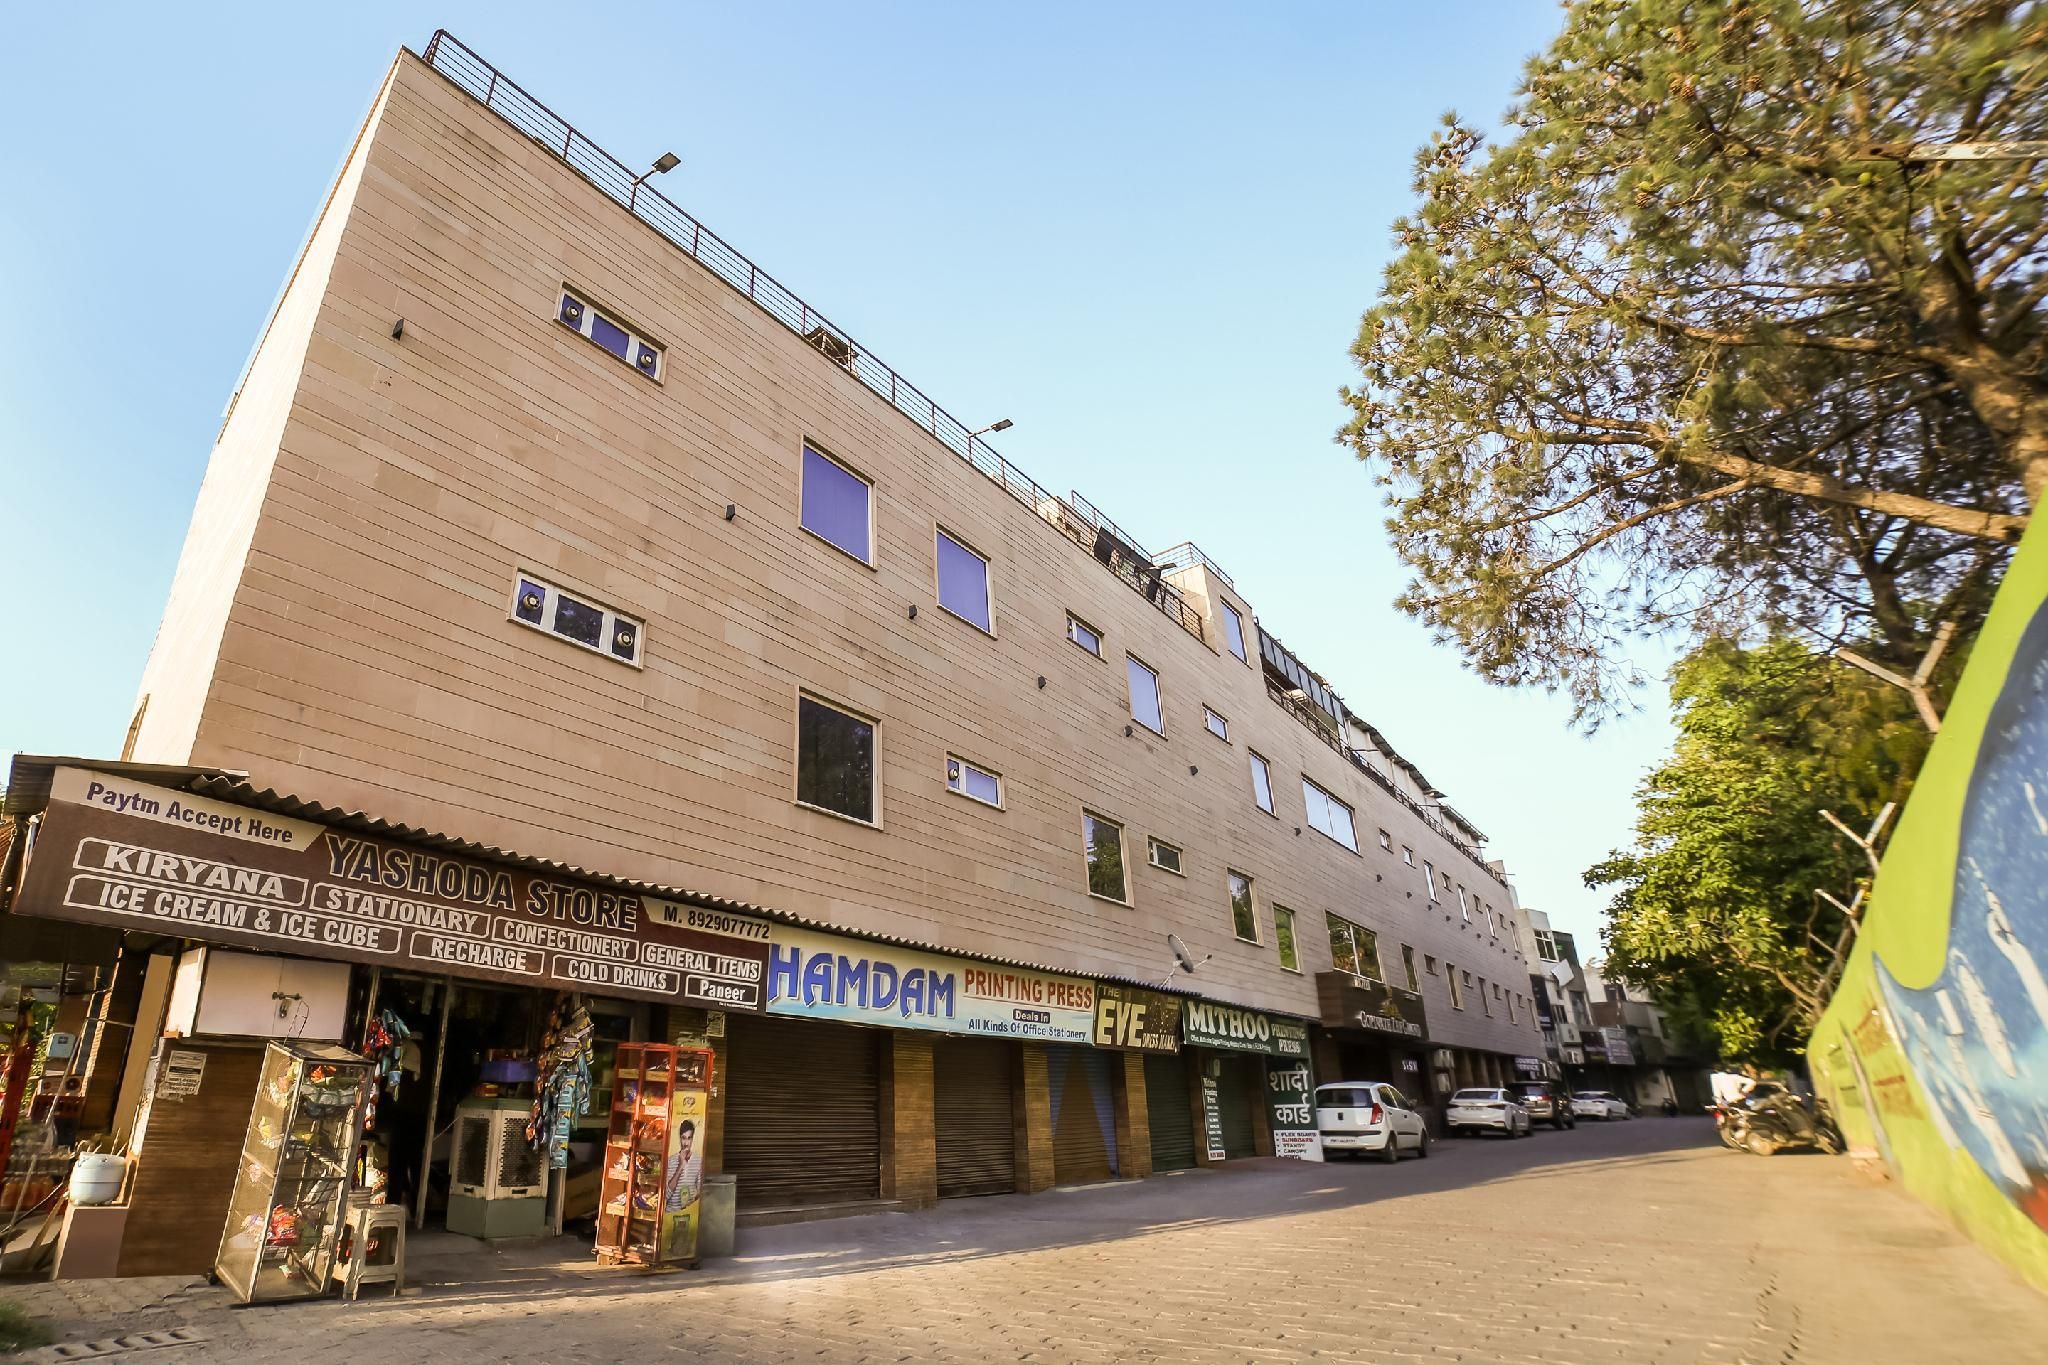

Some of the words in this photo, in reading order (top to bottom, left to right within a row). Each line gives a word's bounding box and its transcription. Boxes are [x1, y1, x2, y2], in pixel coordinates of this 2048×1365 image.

[86, 781, 160, 815] Paytm
[165, 801, 241, 834] Accept
[247, 818, 293, 843] Here
[102, 846, 284, 899] KIRYANA
[323, 833, 516, 911] YASHODA
[526, 879, 638, 933] STORE
[99, 882, 145, 912] ICE
[154, 889, 247, 928] CREAM
[254, 908, 271, 931] &
[278, 911, 319, 939] ICE
[323, 920, 381, 948] CUBE
[326, 888, 478, 933] STATIONARY
[663, 905, 682, 925] M.
[687, 910, 770, 939] 8929077772
[431, 937, 527, 971] RECHARGE
[503, 921, 631, 960] CONFECTIONERY
[567, 959, 609, 983] COLD
[612, 966, 667, 991] DRINKS
[646, 945, 713, 972] GENERAL
[715, 957, 759, 979] ITEMS
[700, 979, 746, 1001] Paneer
[767, 943, 956, 1020] HAMDAM
[964, 968, 1042, 1003] PRINTING
[1047, 982, 1092, 1009] PRESS
[1103, 986, 1120, 998] THE
[968, 1019, 980, 1030] All
[983, 1020, 1008, 1033] Kinds
[1010, 1022, 1021, 1033] Of
[1023, 1023, 1046, 1036] Office
[1049, 1025, 1086, 1041] Statonery
[1015, 1010, 1038, 1021] Deals
[1040, 1012, 1049, 1023] In
[1096, 999, 1146, 1047] EVE
[1187, 1001, 1270, 1042] MITHOO
[1279, 1039, 1301, 1053] PRESS
[1269, 1062, 1308, 1092] शादी
[1274, 1093, 1311, 1124] कार्ड
